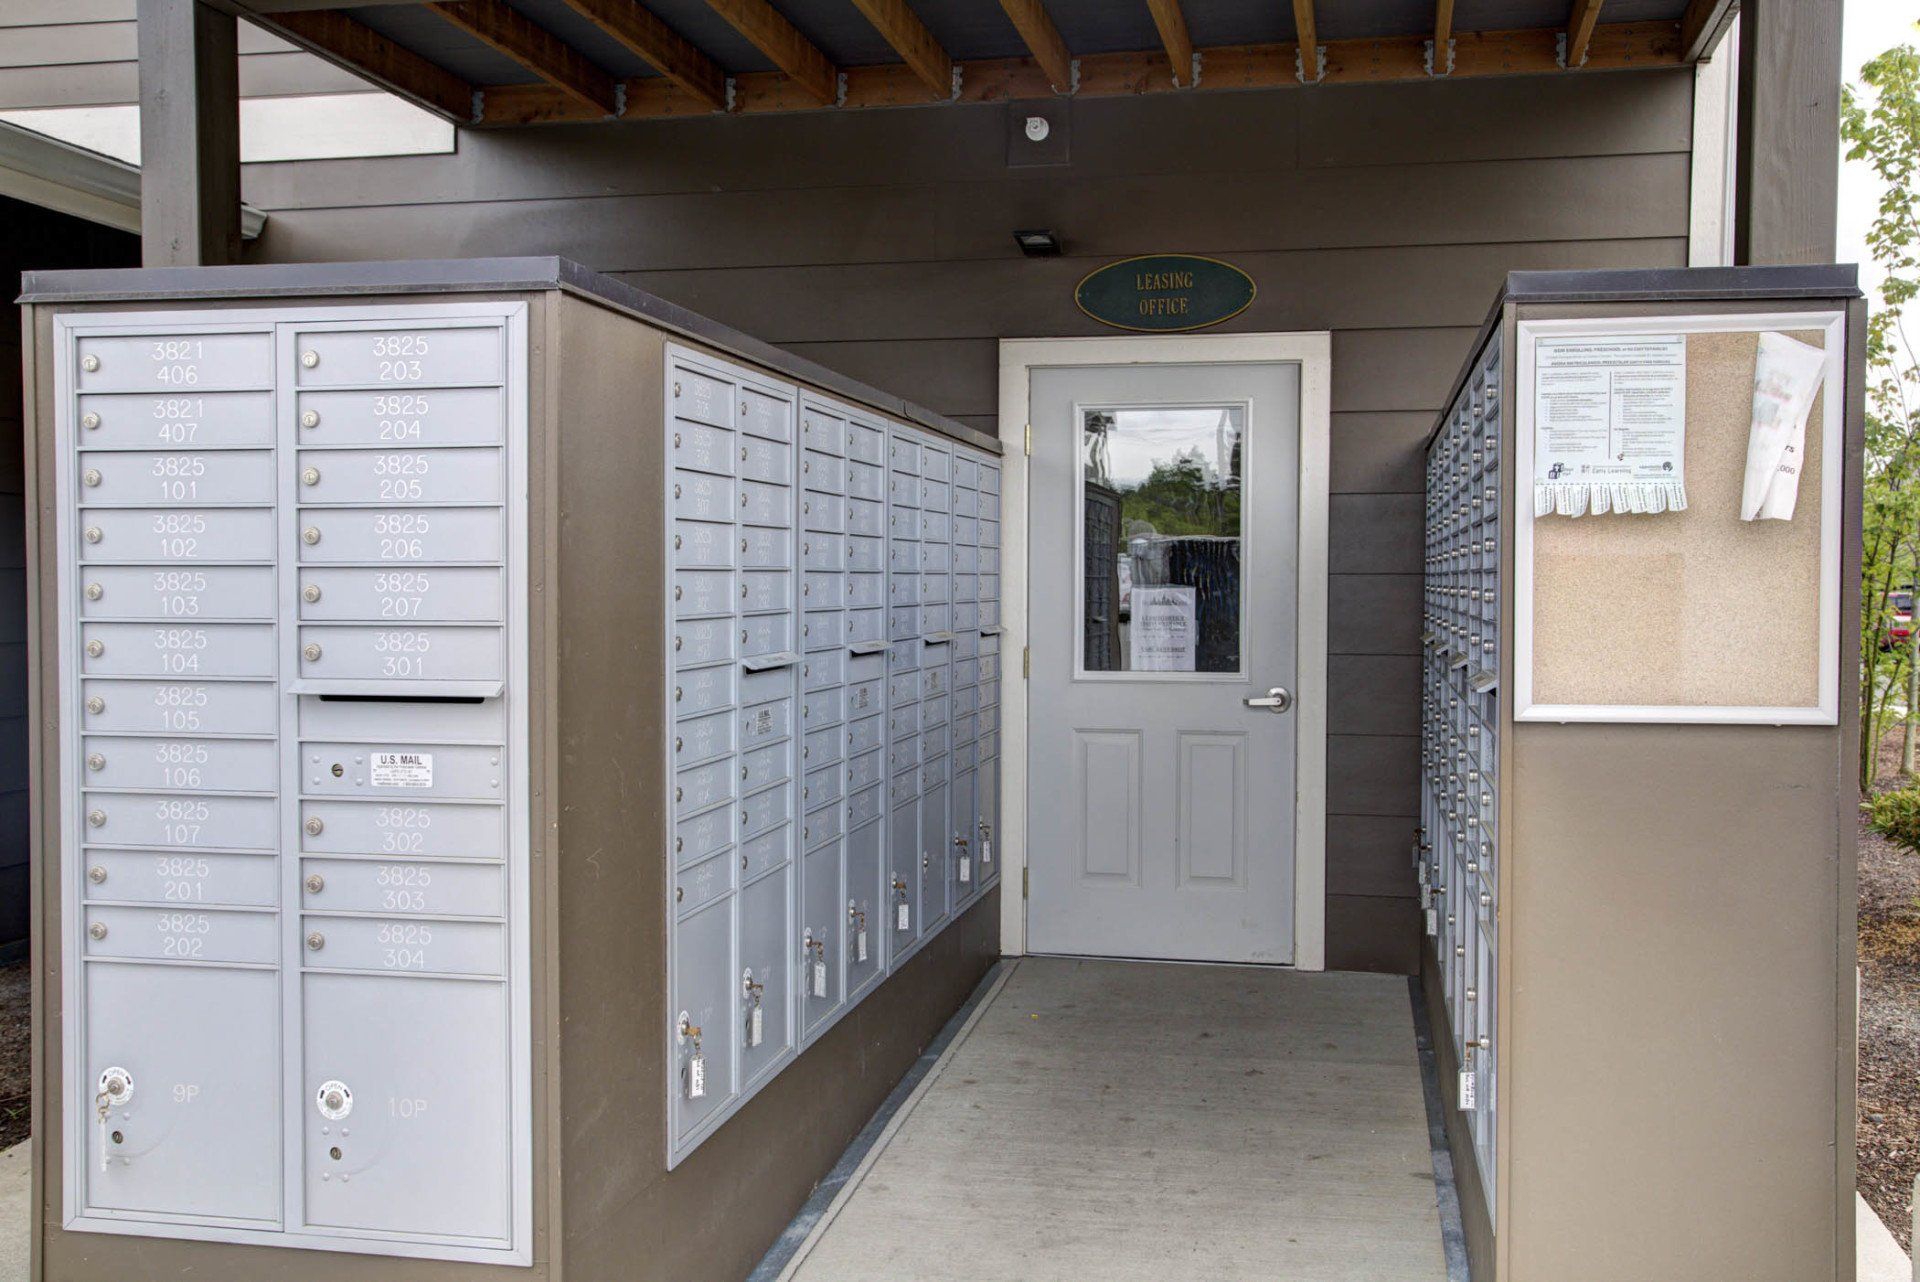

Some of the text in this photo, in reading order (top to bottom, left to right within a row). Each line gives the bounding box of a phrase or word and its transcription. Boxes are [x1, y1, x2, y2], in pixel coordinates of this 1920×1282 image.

[1136, 271, 1193, 290] LEASING
[1139, 297, 1188, 316] OFFICE
[152, 342, 203, 360] 3821
[373, 337, 428, 356] 3825
[157, 366, 197, 384] 406
[379, 361, 422, 381] 203
[152, 400, 203, 418] 3821
[374, 396, 429, 415] 3825
[158, 424, 198, 442] 407
[380, 421, 421, 440] 204
[152, 457, 205, 476] 3825
[374, 455, 429, 475] 3825
[161, 481, 197, 499] 101
[380, 480, 422, 499] 205
[153, 516, 205, 533] 3825
[374, 515, 429, 534] 3825
[161, 539, 197, 557] 102
[381, 539, 422, 558] 206
[154, 573, 206, 591] 3825
[374, 574, 429, 592] 3825
[162, 597, 198, 614] 103
[382, 598, 422, 617] 207
[154, 630, 206, 648] 3825
[375, 633, 430, 651] 3825
[162, 654, 198, 672] 104
[383, 657, 423, 676] 301
[155, 688, 207, 706] 3825
[163, 711, 199, 729] 105
[156, 745, 208, 763] 3825
[380, 754, 422, 765] U.S. MAIL
[164, 769, 201, 787] 106
[156, 801, 208, 820] 3825
[375, 809, 431, 828] 3825
[165, 826, 201, 844] 107
[382, 833, 423, 852] 302
[157, 859, 209, 876] 3825
[376, 867, 431, 886] 3825
[165, 882, 203, 900] 201
[383, 891, 424, 911] 303
[157, 915, 210, 933] 3825
[377, 925, 432, 945] 3825
[164, 939, 203, 957] 202
[383, 950, 424, 968] 304
[172, 1083, 200, 1104] 9P
[386, 1097, 428, 1120] 10P
